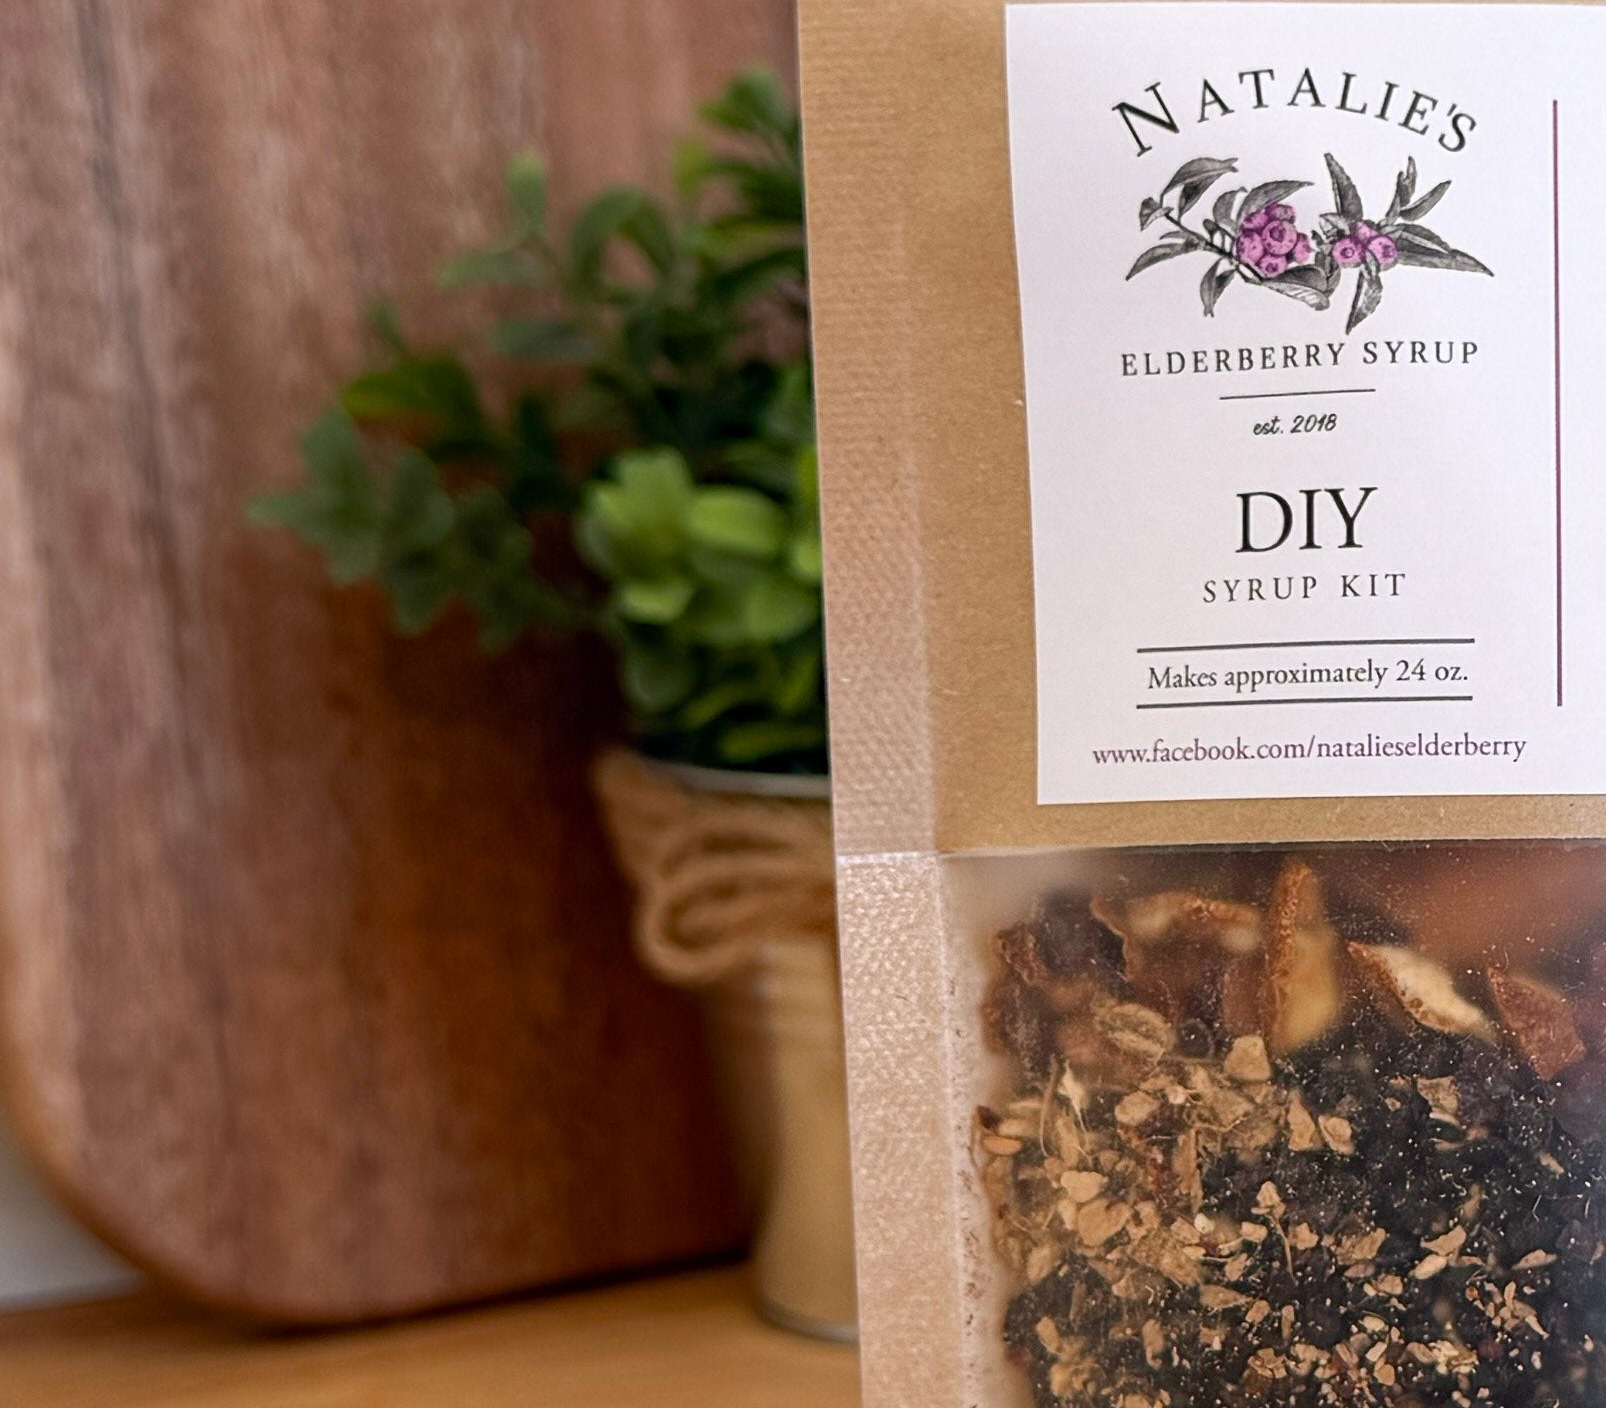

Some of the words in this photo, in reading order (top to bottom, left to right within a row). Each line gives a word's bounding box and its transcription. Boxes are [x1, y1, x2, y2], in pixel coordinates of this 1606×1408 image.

[1111, 67, 1477, 157] NATALIE'S
[1121, 342, 1345, 376] ELDERBERRY
[1363, 341, 1478, 364] SYRUP
[1253, 415, 1284, 436] est.
[1290, 413, 1337, 434] 2018
[1235, 486, 1378, 553] DIY
[1203, 576, 1317, 603] SYRUP
[1341, 573, 1406, 598] KIT
[1148, 664, 1217, 689] Makes
[1224, 658, 1389, 694] approximately
[1396, 658, 1426, 681] 24
[1435, 666, 1468, 681] oz.
[1092, 732, 1527, 764] www.facebook.com/natalieselderberry
